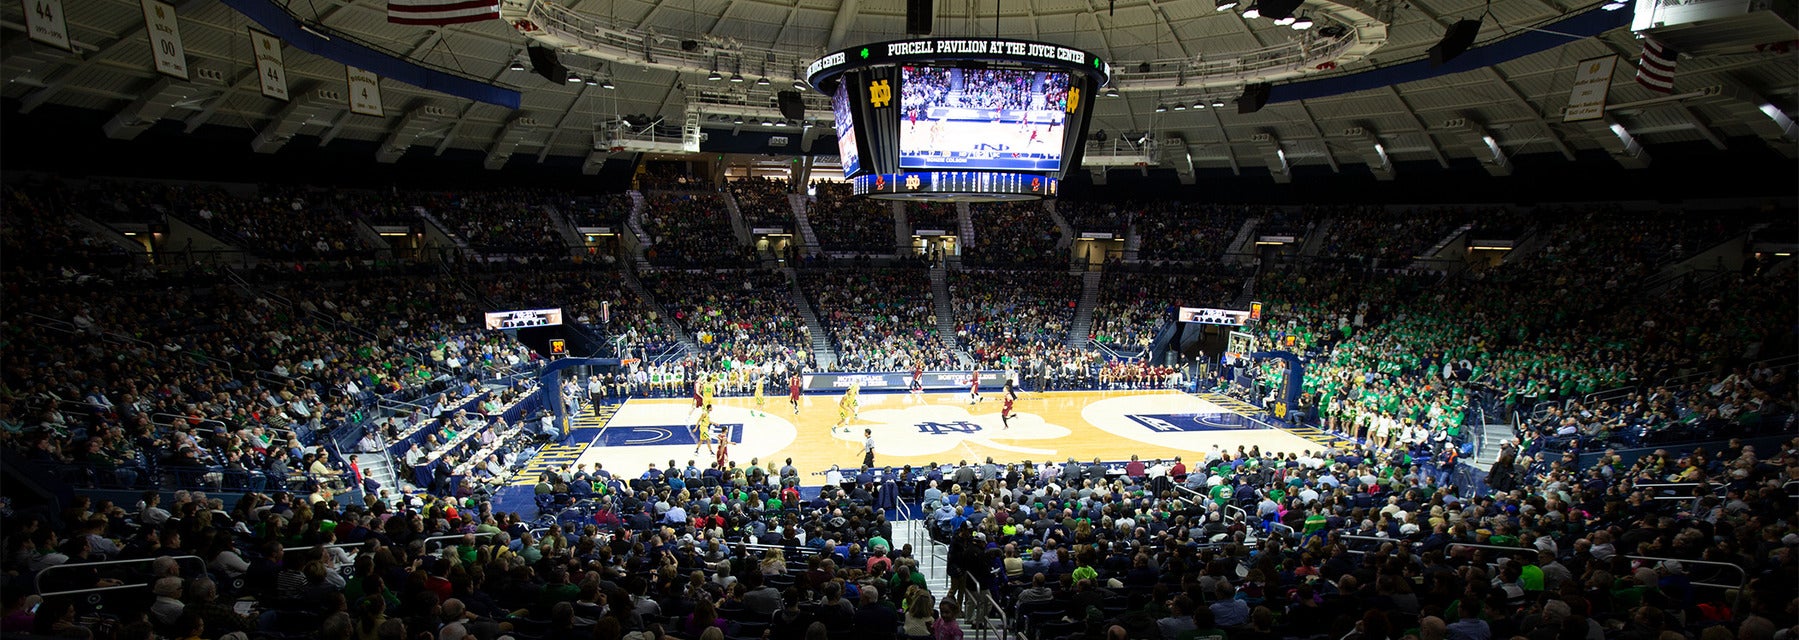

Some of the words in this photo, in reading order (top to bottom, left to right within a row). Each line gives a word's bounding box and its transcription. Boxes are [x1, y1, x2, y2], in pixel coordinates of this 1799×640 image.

[36, 0, 54, 22] 44
[161, 39, 175, 57] 00
[888, 41, 934, 57] PURCELL
[937, 40, 988, 55] PAVILION
[989, 41, 1005, 54] AT
[1006, 42, 1026, 56] THE
[1027, 43, 1055, 59] JOYCE
[1057, 47, 1085, 65] CENTER
[823, 52, 846, 69] CENTER
[267, 67, 279, 82] 44
[361, 88, 368, 100] 4
